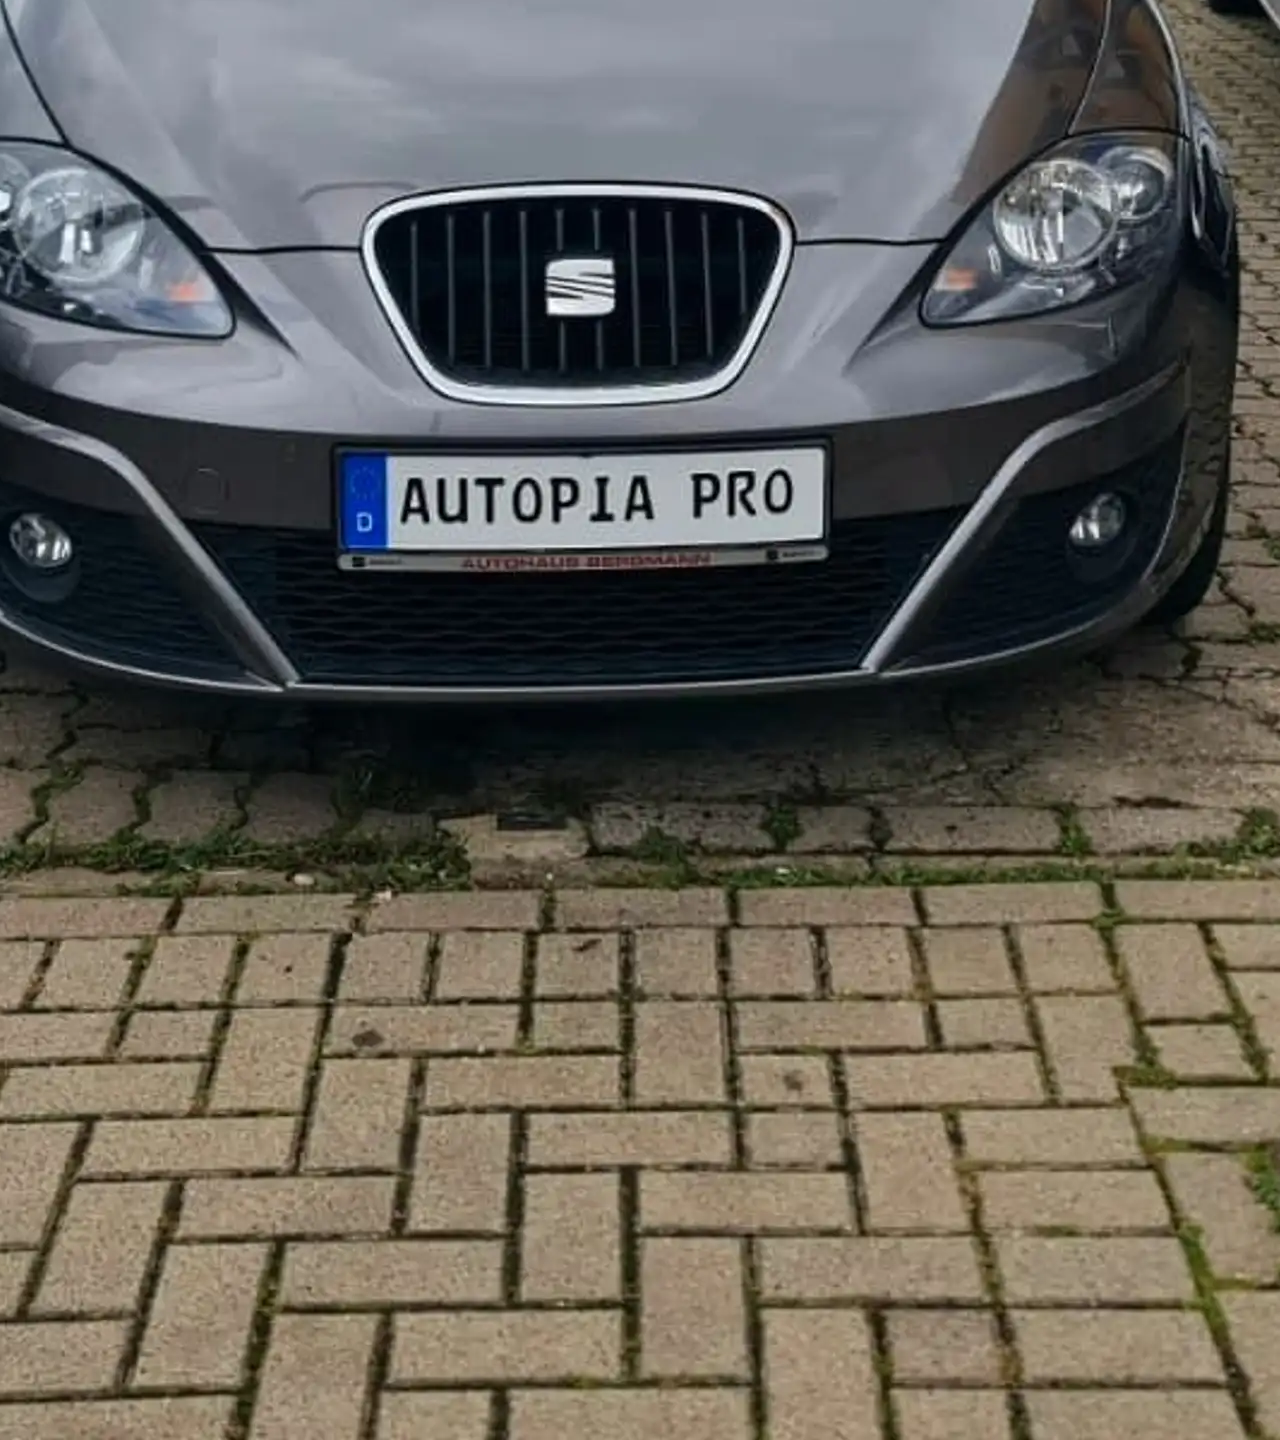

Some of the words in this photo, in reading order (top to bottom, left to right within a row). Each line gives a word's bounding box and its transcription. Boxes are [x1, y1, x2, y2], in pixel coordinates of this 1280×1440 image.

[400, 475, 654, 525] AUTOPIA
[690, 469, 794, 518] PRO
[356, 512, 372, 532] D
[461, 556, 579, 570] AUTOHAUS
